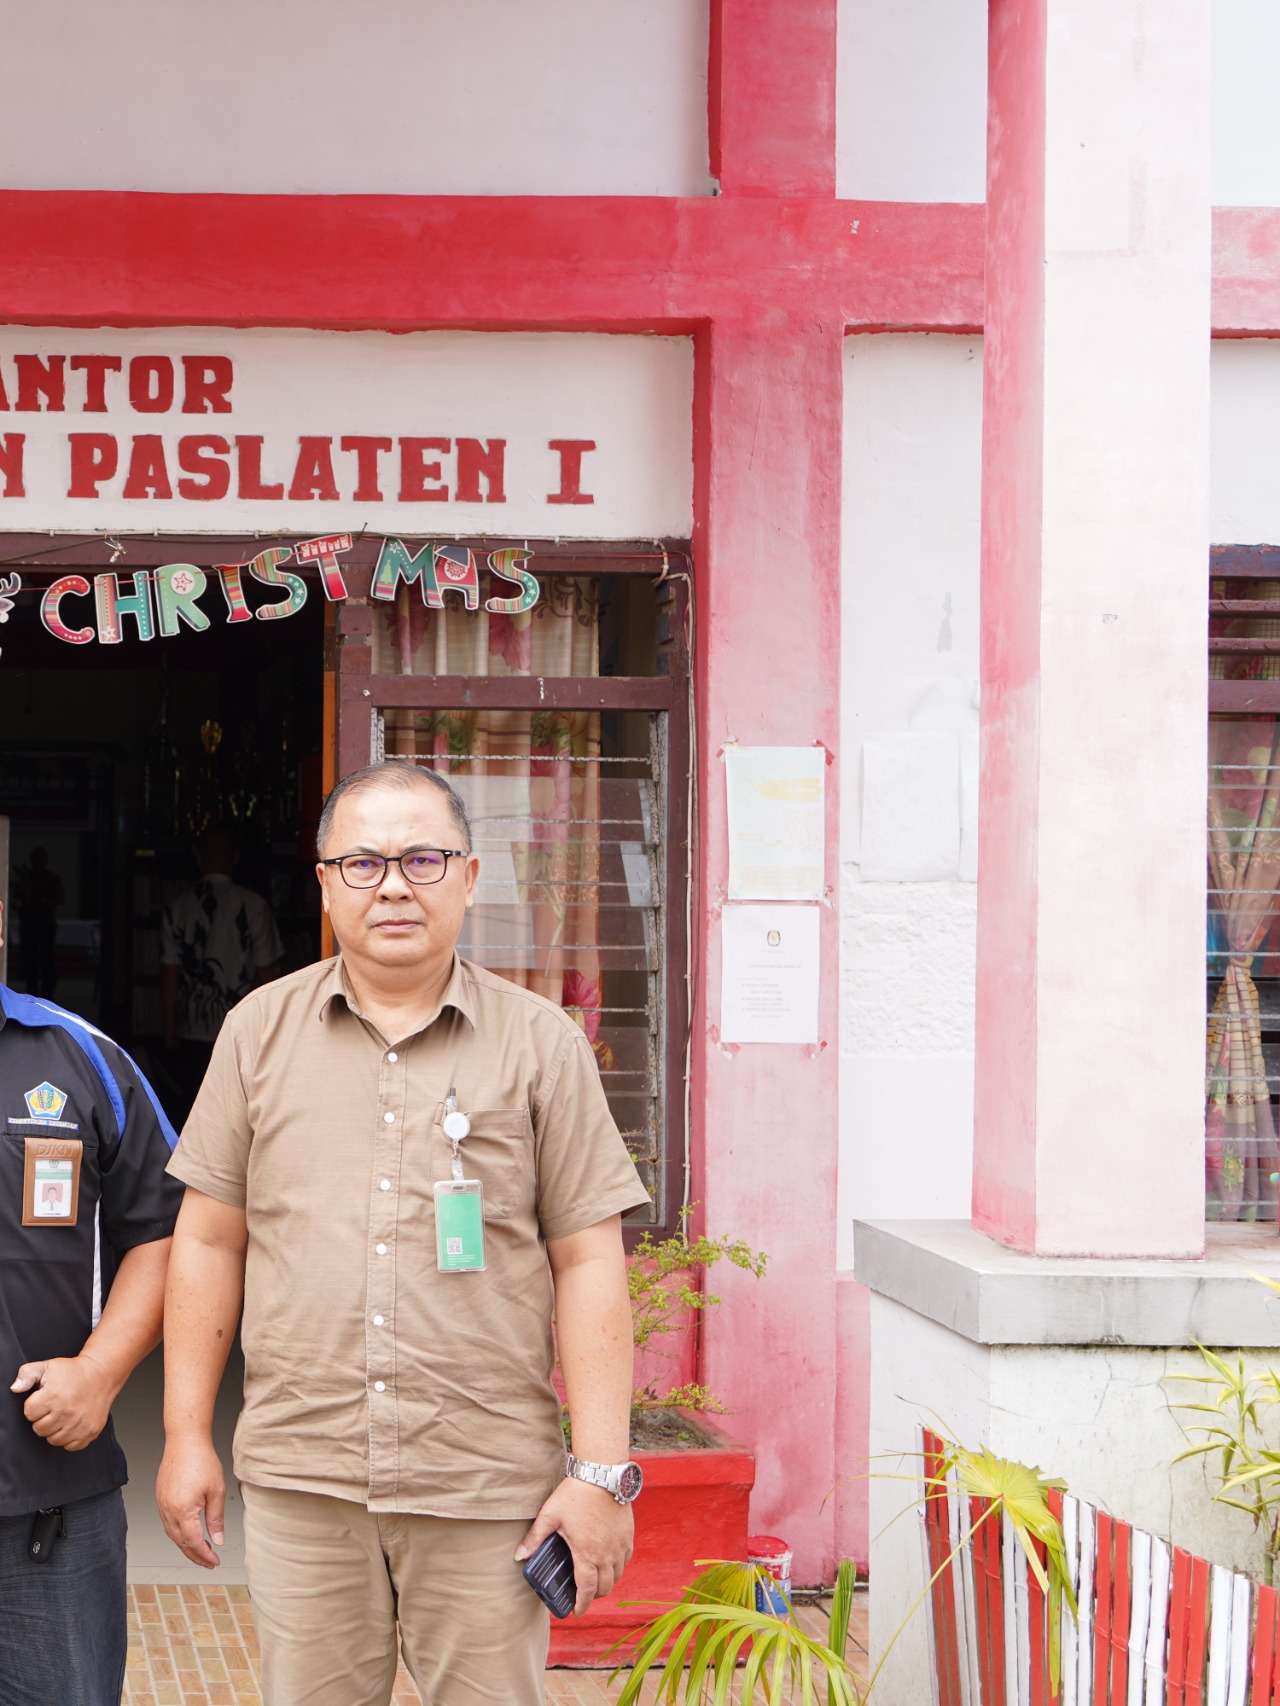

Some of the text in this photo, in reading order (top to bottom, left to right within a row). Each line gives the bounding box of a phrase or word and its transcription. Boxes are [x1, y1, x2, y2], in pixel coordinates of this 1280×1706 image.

[67, 432, 507, 504] PASLATEN
[547, 439, 596, 504] I
[35, 1144, 74, 1157] DJKN
